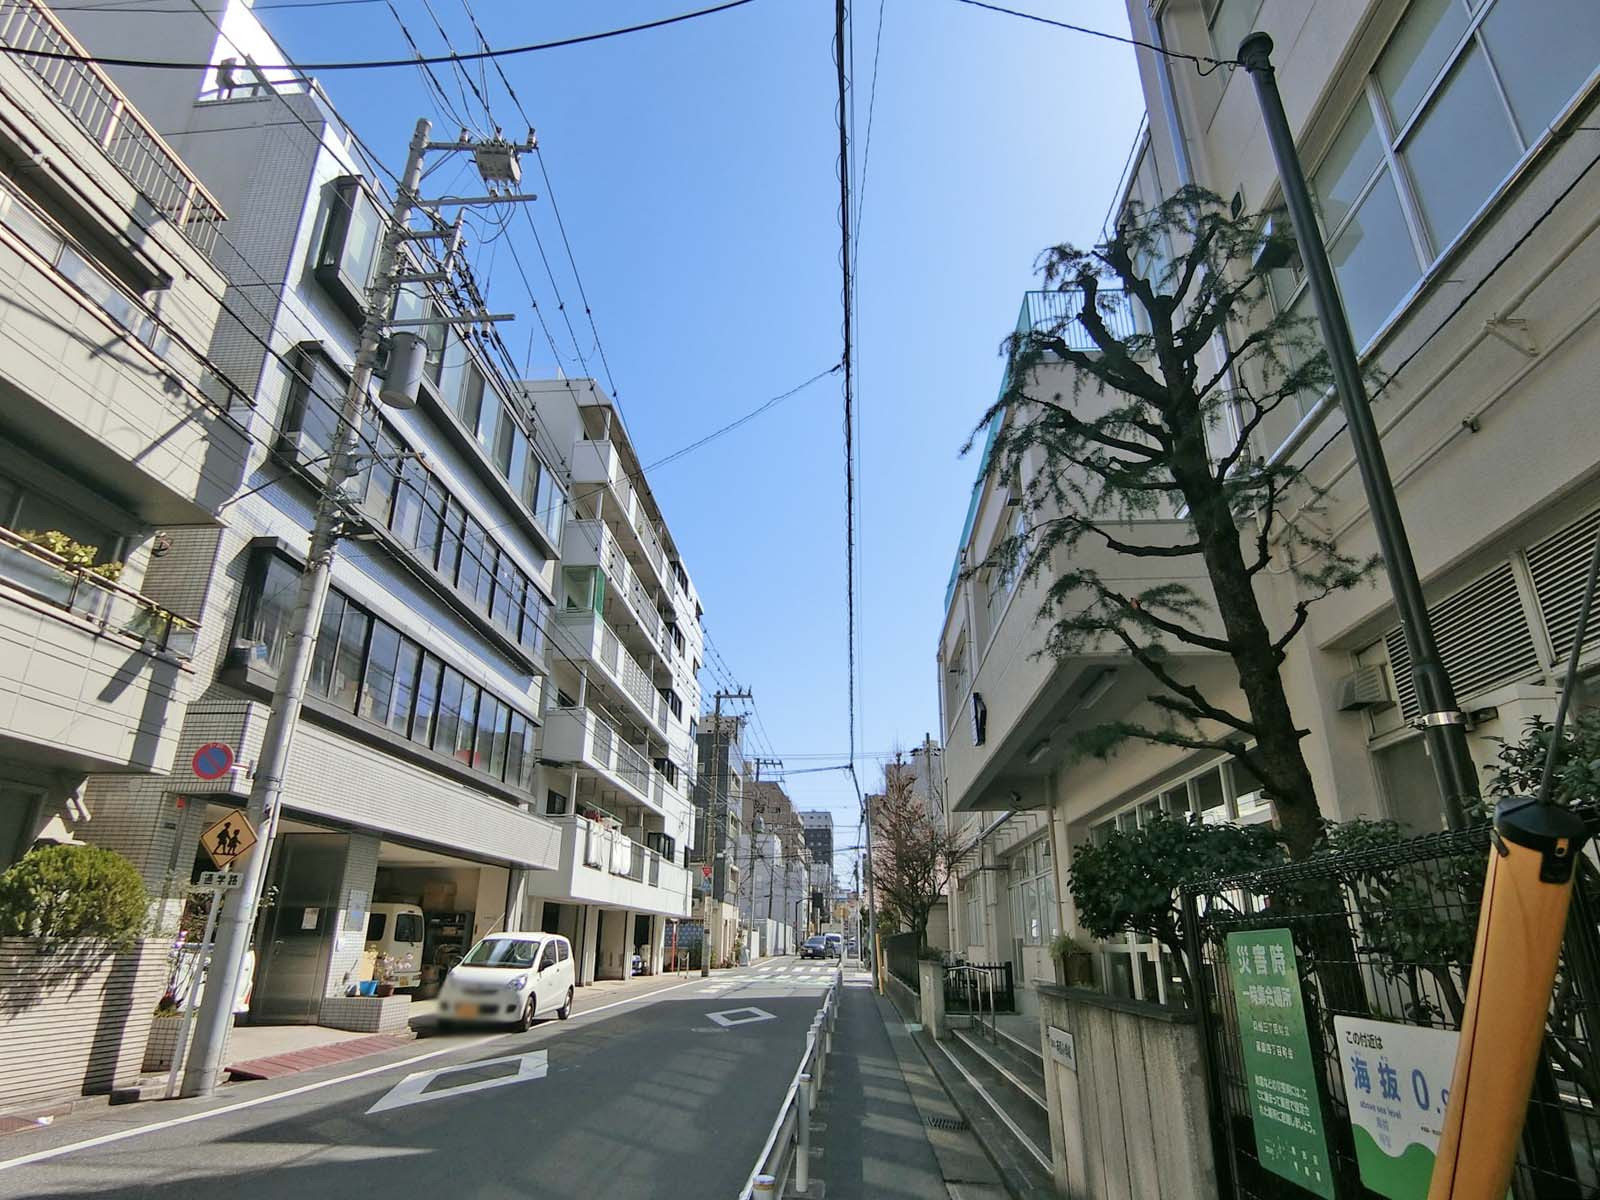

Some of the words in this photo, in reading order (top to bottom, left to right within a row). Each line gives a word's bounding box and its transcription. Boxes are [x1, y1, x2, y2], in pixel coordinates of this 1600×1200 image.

[203, 873, 239, 886] 通学路
[1236, 943, 1286, 976] 災害時
[1345, 1030, 1384, 1050] この付近は
[1350, 1055, 1401, 1102] 海抜
